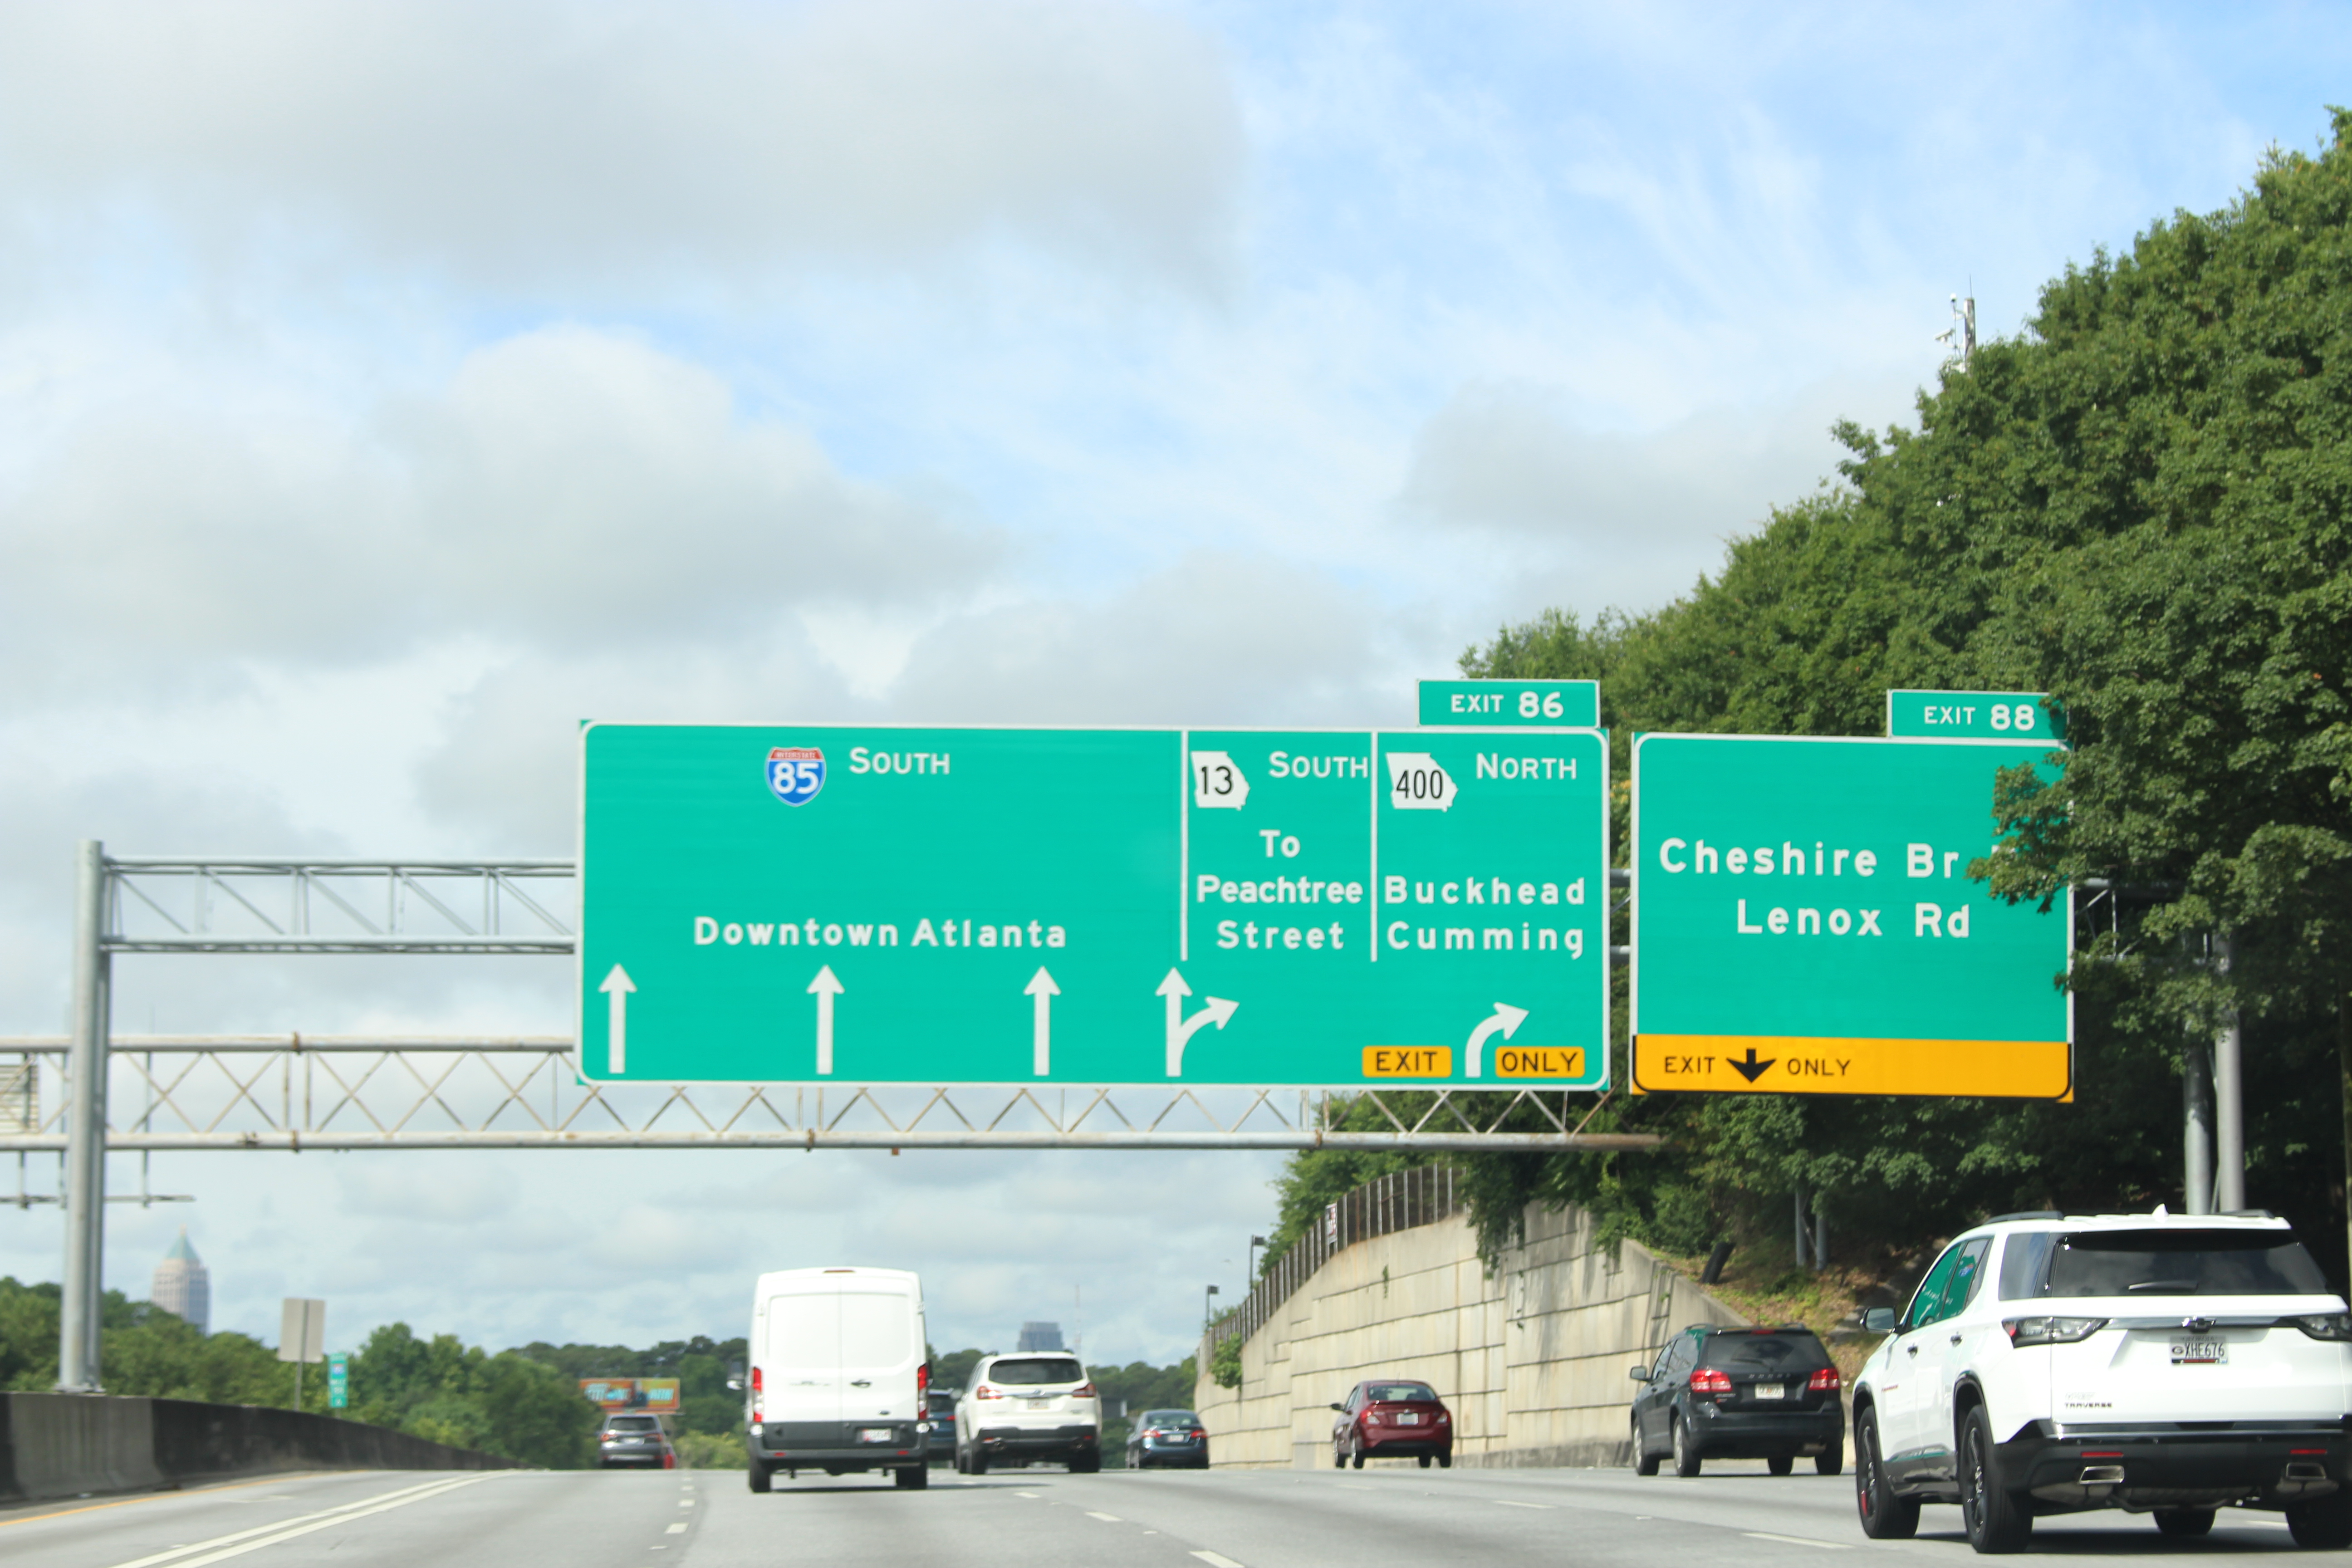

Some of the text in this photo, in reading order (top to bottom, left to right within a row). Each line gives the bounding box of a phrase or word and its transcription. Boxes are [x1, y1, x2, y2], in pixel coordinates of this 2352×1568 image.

[1451, 691, 1564, 718] EXIT 86
[1924, 704, 2035, 731] EXIT 88
[773, 747, 951, 794] 85 SOUTH
[1201, 751, 1368, 795] 13 SOUTH
[1396, 753, 1577, 800] 400 NORTH
[1259, 830, 1300, 858] To
[1660, 838, 1877, 877] Cheshire
[1907, 843, 1959, 878] Br
[1197, 875, 1363, 904] Peachtree
[1385, 876, 1584, 905] Buckhead
[695, 916, 1066, 948] Downtown Atlanta
[1737, 899, 1970, 938] Lenox Rd
[1217, 920, 1344, 950] Street
[1387, 921, 1583, 960] Cumming
[1375, 1052, 1578, 1072] EXIT ONLY
[1664, 1055, 1851, 1077] EXIT ONLY
[2185, 1342, 2225, 1358] XHE676
